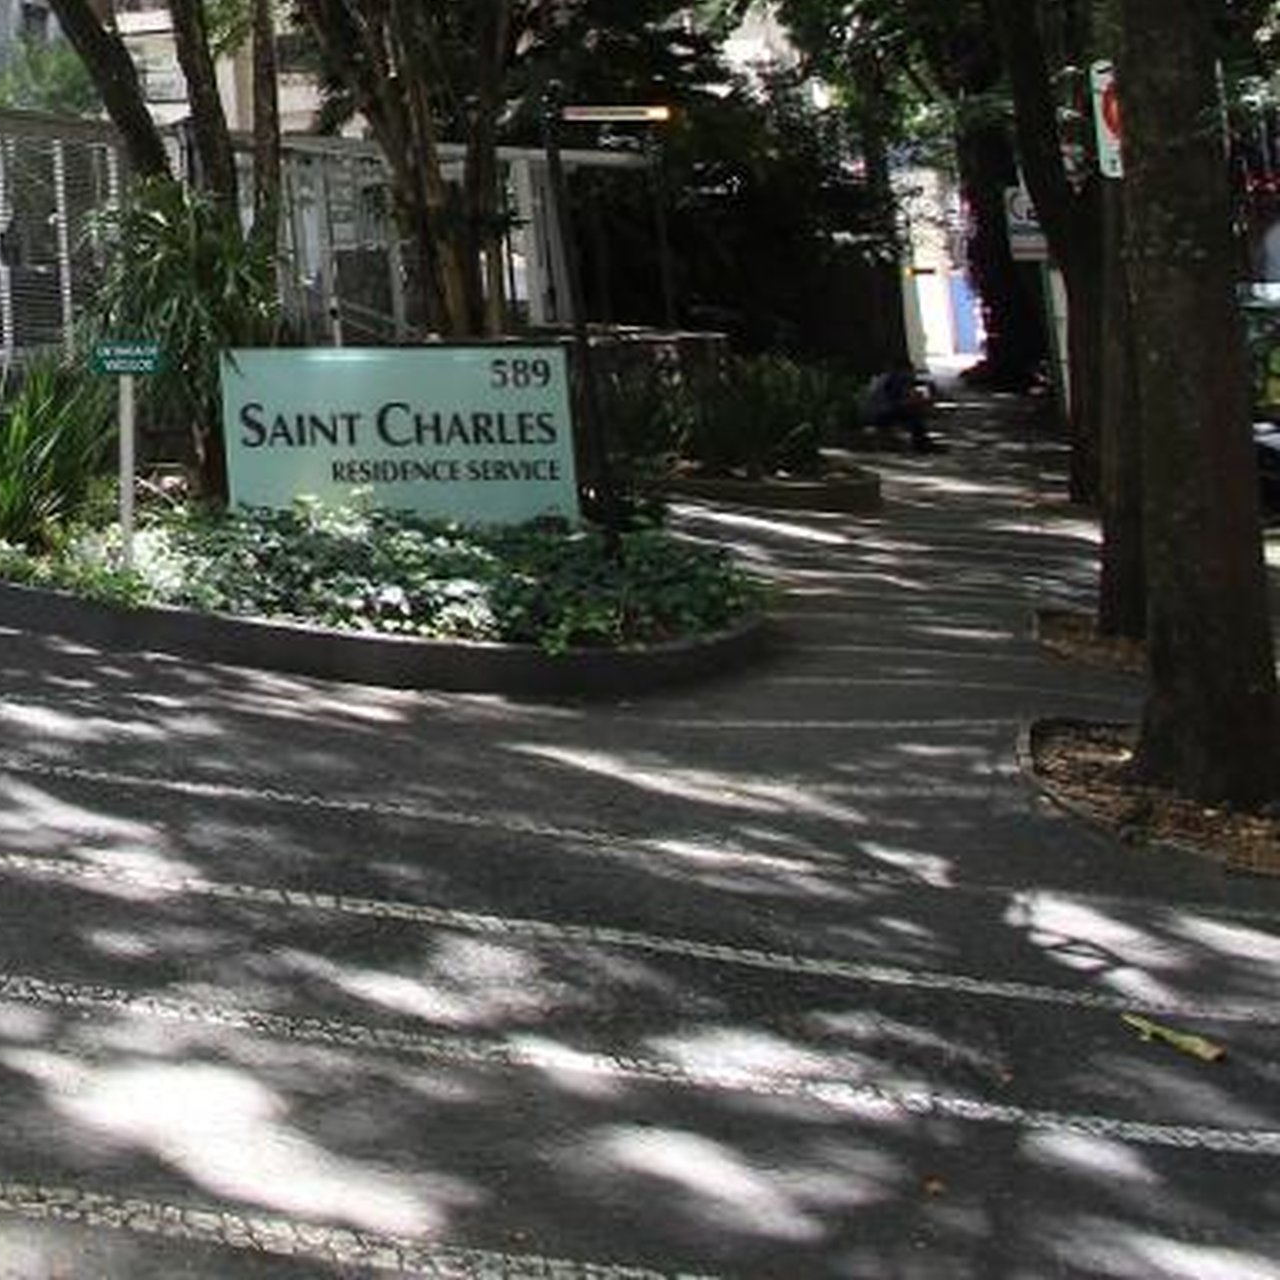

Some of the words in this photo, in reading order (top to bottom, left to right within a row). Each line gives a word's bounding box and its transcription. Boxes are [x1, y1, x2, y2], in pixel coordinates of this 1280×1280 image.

[490, 359, 551, 388] 589
[239, 402, 362, 448] SAINT
[376, 402, 558, 448] CHARLES
[331, 460, 460, 482] RESIDENCE
[462, 460, 560, 482] SERVICE
